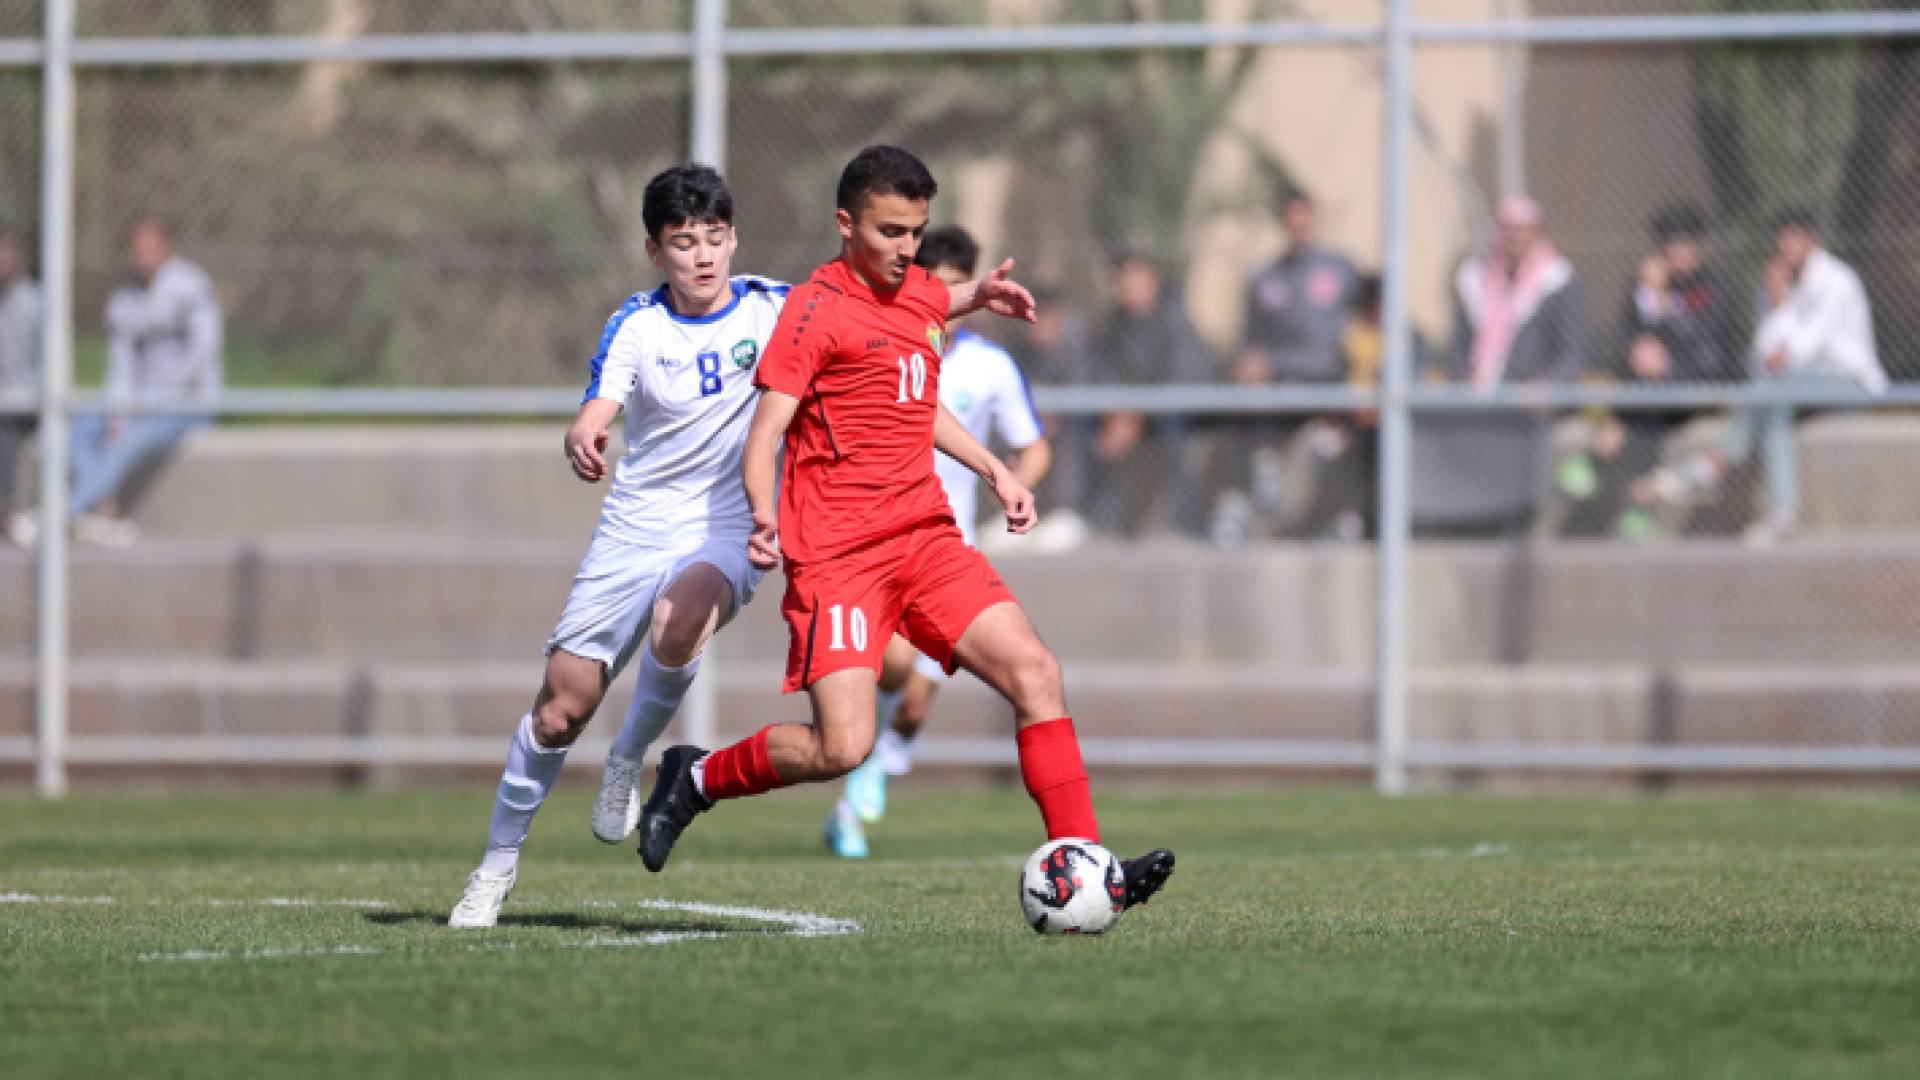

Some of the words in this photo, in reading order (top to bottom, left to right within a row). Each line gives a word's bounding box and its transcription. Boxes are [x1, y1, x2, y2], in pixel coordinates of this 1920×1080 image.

[697, 351, 721, 397] 8
[896, 352, 926, 403] 10
[828, 604, 868, 651] 10
